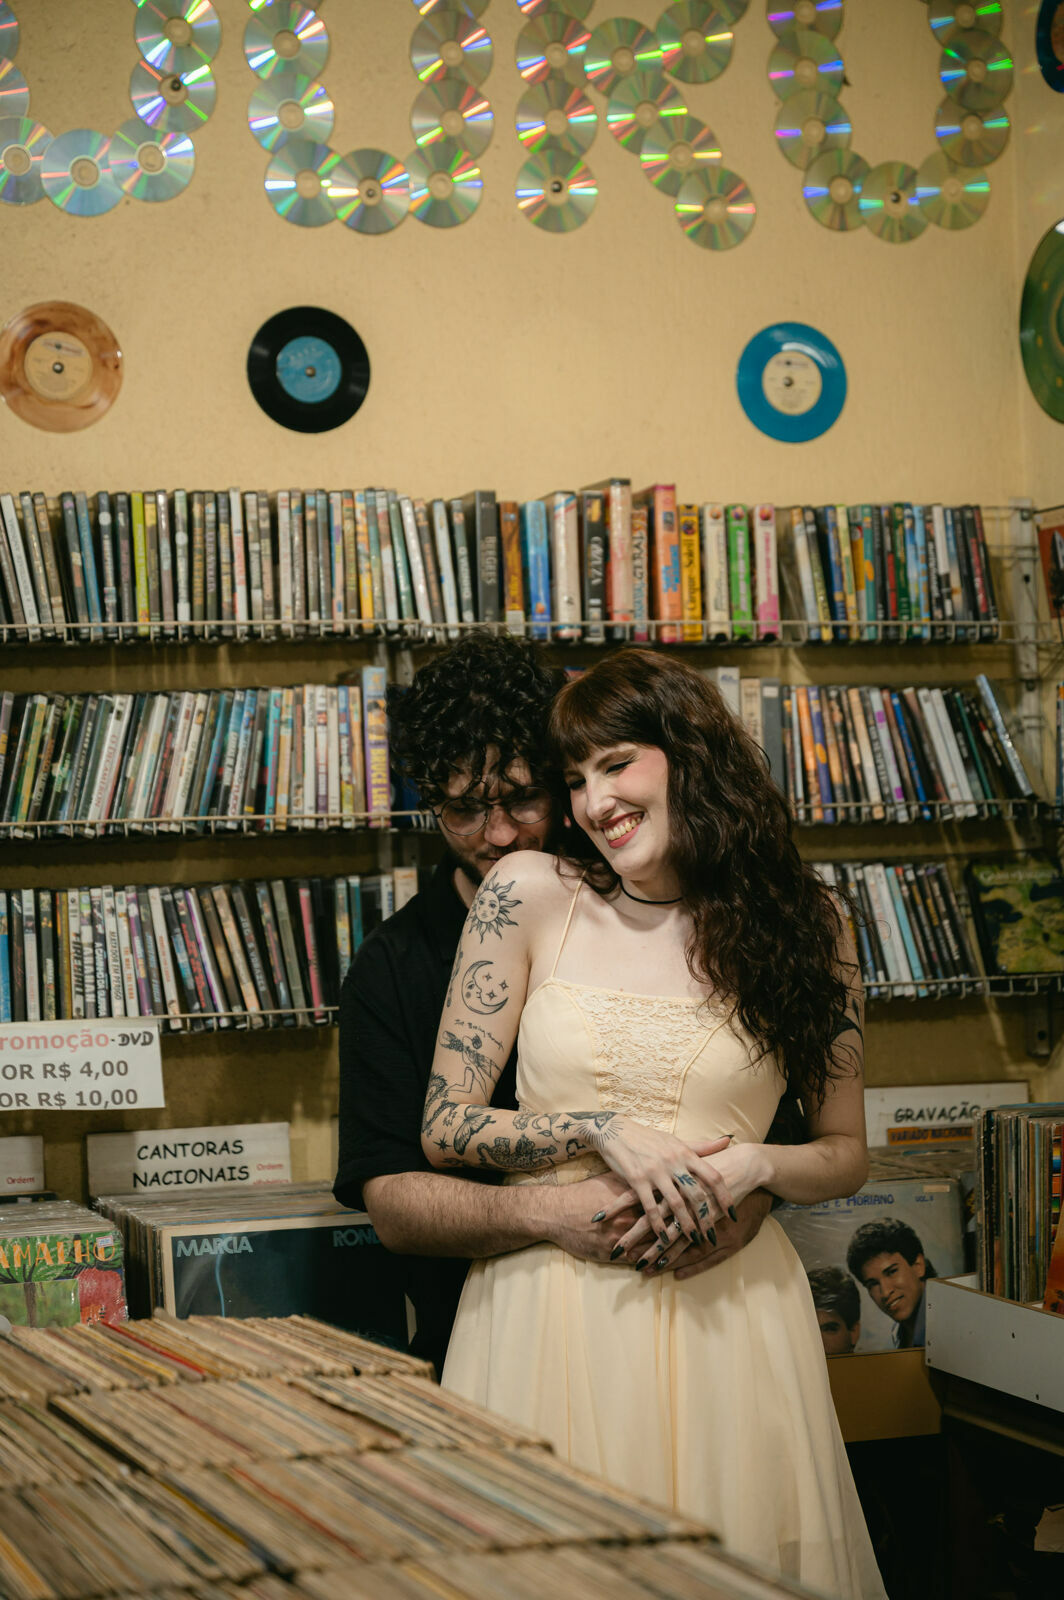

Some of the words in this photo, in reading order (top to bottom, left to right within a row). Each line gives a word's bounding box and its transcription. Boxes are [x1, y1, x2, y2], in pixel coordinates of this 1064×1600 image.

[371, 748, 387, 784] BRUCE
[43, 1062, 71, 1081] R$
[80, 1060, 128, 1080] 4,00
[38, 1091, 66, 1109] R$
[75, 1089, 138, 1109] 10,00
[137, 1139, 244, 1160] CANTORAS
[132, 1165, 249, 1188] NACIONAIS
[177, 1236, 253, 1257] MARCIA
